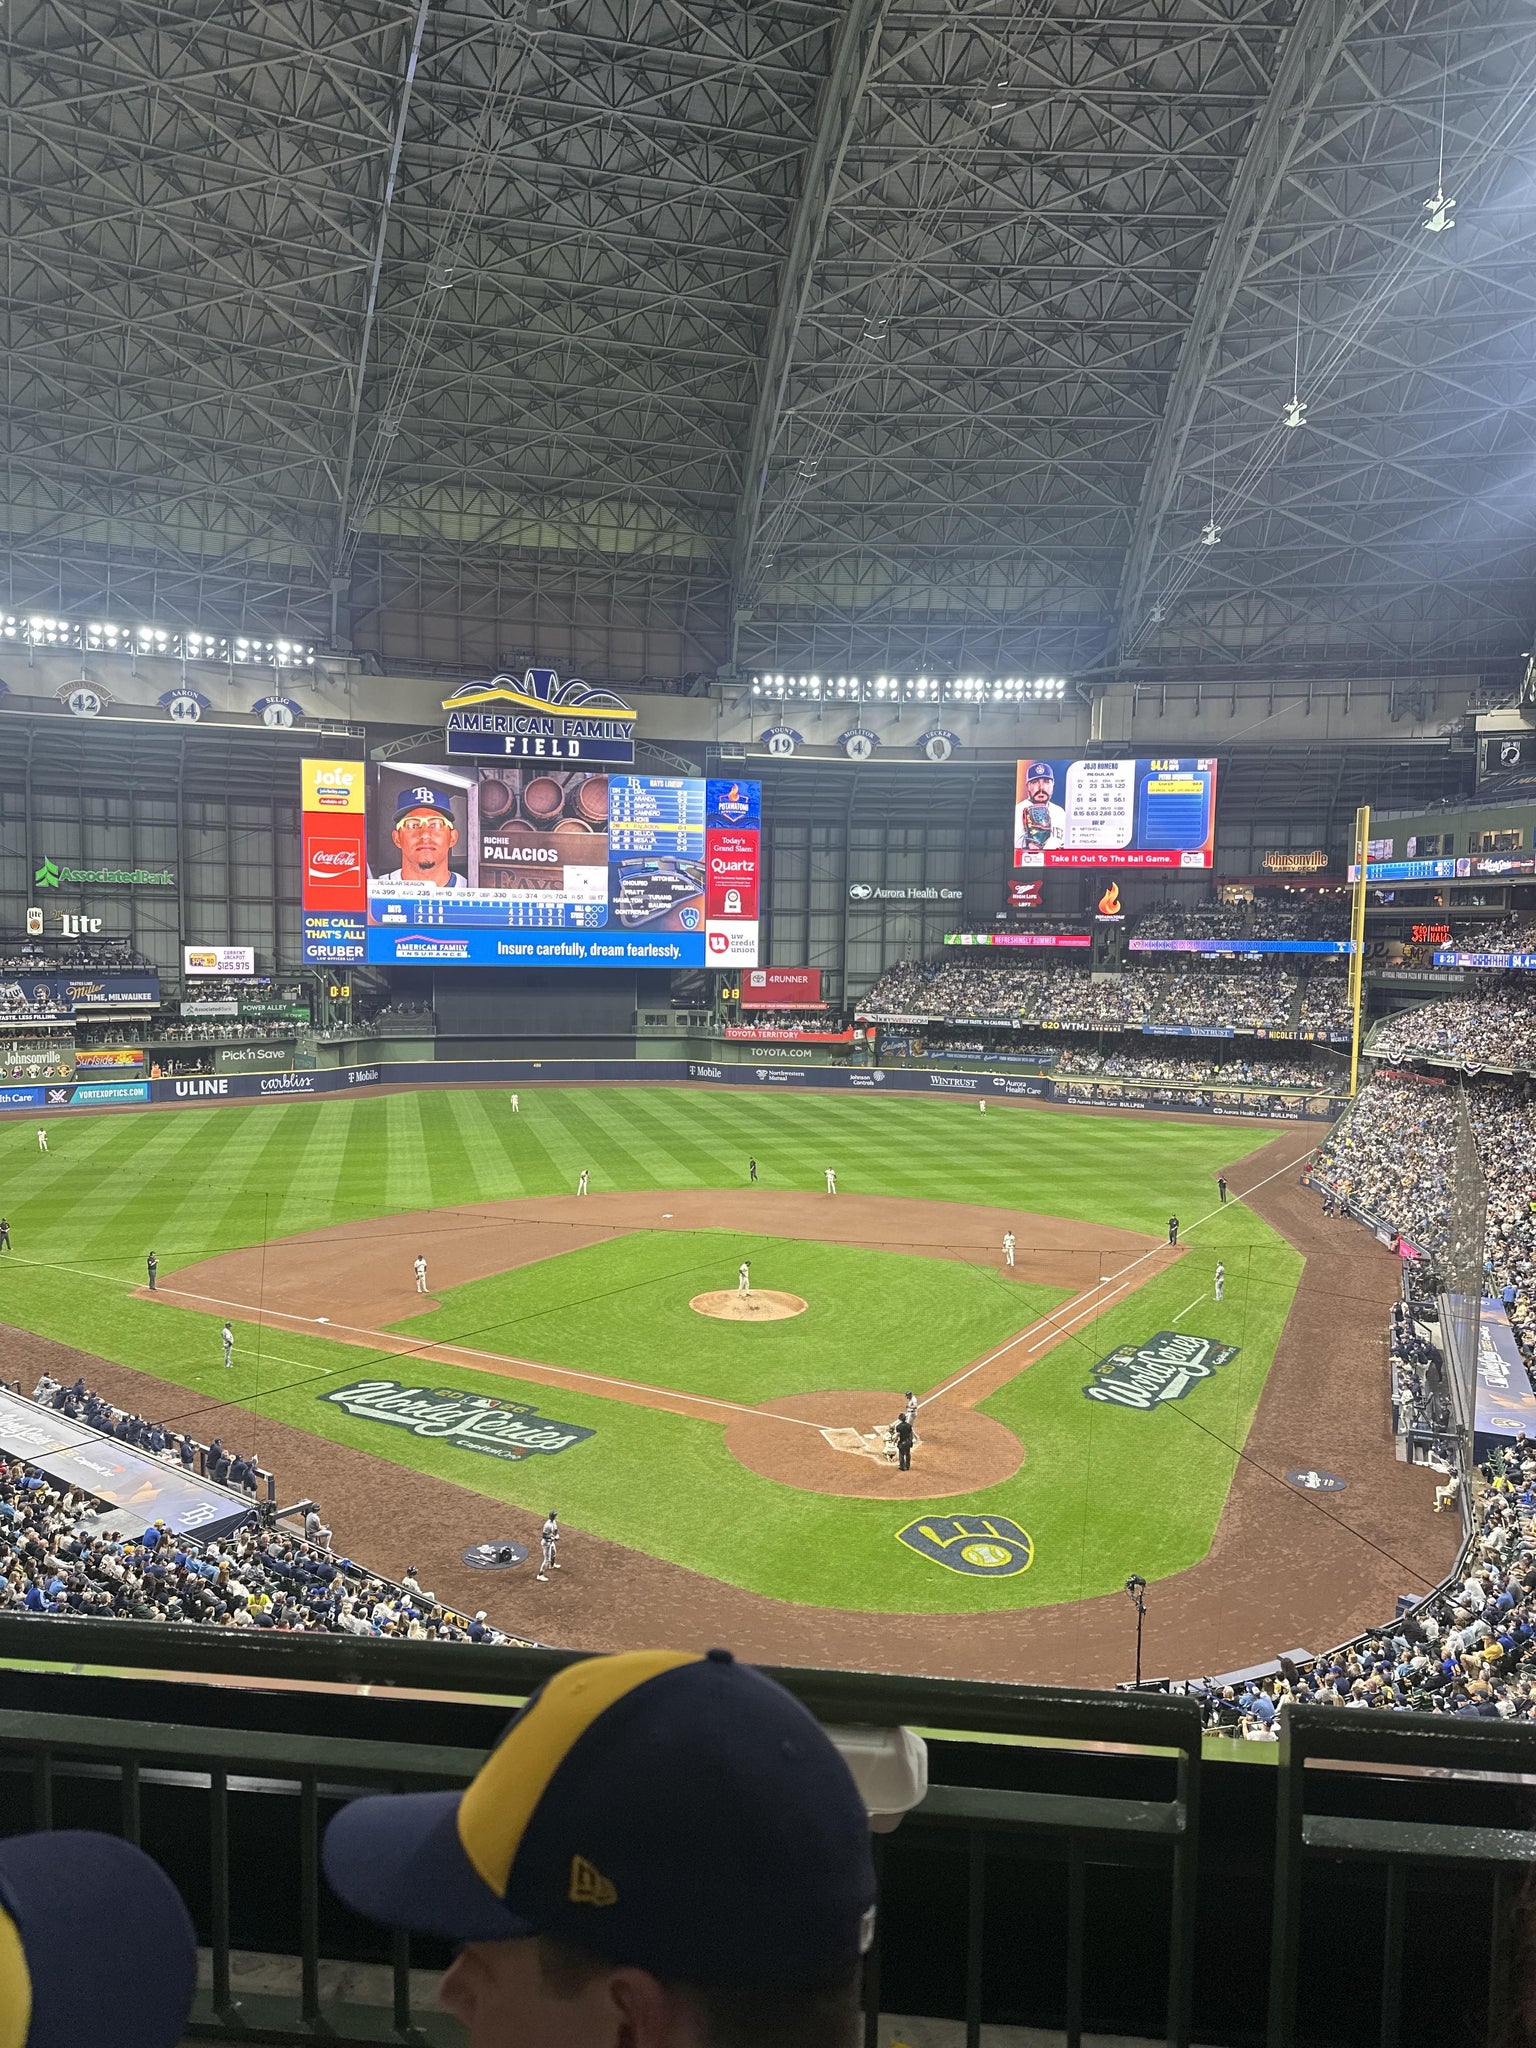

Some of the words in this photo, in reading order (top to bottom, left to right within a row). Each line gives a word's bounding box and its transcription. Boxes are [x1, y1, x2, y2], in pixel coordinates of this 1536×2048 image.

[171, 690, 199, 699] AARON
[265, 696, 290, 705] SELIG
[72, 694, 99, 711] 42
[173, 702, 198, 719] 44
[274, 711, 284, 726] 1
[447, 712, 556, 737] AMERICAN
[561, 718, 636, 741] FAMILY
[770, 726, 794, 735] YOUNT
[843, 730, 875, 739] MOLITOR
[924, 730, 952, 739] UECKER
[504, 736, 580, 757] FIELD
[773, 739, 792, 753] 19
[853, 740, 864, 754] 4
[1083, 762, 1097, 770] JOJO
[1097, 762, 1118, 770] ROMERO
[314, 767, 354, 786] Joie
[721, 837, 746, 846] Today's
[312, 850, 357, 866] Coca-Cola
[484, 846, 558, 862] PALACIOS
[1146, 855, 1172, 863] Game.
[1262, 850, 1329, 867] Johnsonville
[711, 858, 754, 874] Quartz
[59, 866, 176, 886] AssociatedBank
[872, 887, 906, 899] Aurora
[906, 887, 938, 899] Health
[940, 888, 963, 899] Care
[61, 914, 103, 938] Lite
[305, 917, 329, 928] ONE
[331, 918, 365, 928] CALL...
[304, 930, 342, 939] THAT'S
[343, 930, 365, 940] ALL!
[306, 945, 364, 957] GRUBER
[396, 943, 437, 951] AMERICAN
[440, 944, 468, 952] FAMILY
[497, 940, 533, 955] Insure
[536, 942, 587, 959] carefully,
[590, 942, 625, 956] dream
[627, 943, 682, 960] fearlessly.
[768, 975, 809, 984] 4RUNNER
[66, 984, 106, 1001] Miller
[87, 993, 108, 1002] TIME,
[108, 993, 152, 1002] MILWAUKEE
[242, 1004, 267, 1012] POWER
[267, 1004, 288, 1012] ALLEY
[1041, 1021, 1060, 1030] 620
[1060, 1022, 1090, 1031] WTMJ
[1190, 1027, 1230, 1037] WINTRUST
[727, 1030, 756, 1038] TOYOTA
[758, 1031, 799, 1039] TERRITORY
[1268, 1031, 1298, 1040] NICOLET
[1299, 1032, 1315, 1040] LAW
[4, 1050, 61, 1066] Johnsonville
[221, 1050, 245, 1060] Pick
[257, 1049, 285, 1060] Save
[750, 1048, 812, 1058] TOYOTA.COM
[76, 1054, 114, 1067] Surfside
[356, 1069, 379, 1082] Mobile
[697, 1066, 722, 1078] Mobile
[260, 1073, 314, 1090] carbliss
[930, 1075, 978, 1087] WINTRUST
[1006, 1080, 1027, 1088] Aurora
[78, 1087, 145, 1100] VORTEXOPTICS.COM
[175, 1079, 228, 1097] ULINE
[1005, 1086, 1026, 1094] Health
[1026, 1087, 1042, 1095] Care
[12, 1094, 34, 1103] Care
[1270, 1111, 1299, 1120] BULLPEN
[328, 1380, 457, 1425] World
[414, 1409, 580, 1450] Series
